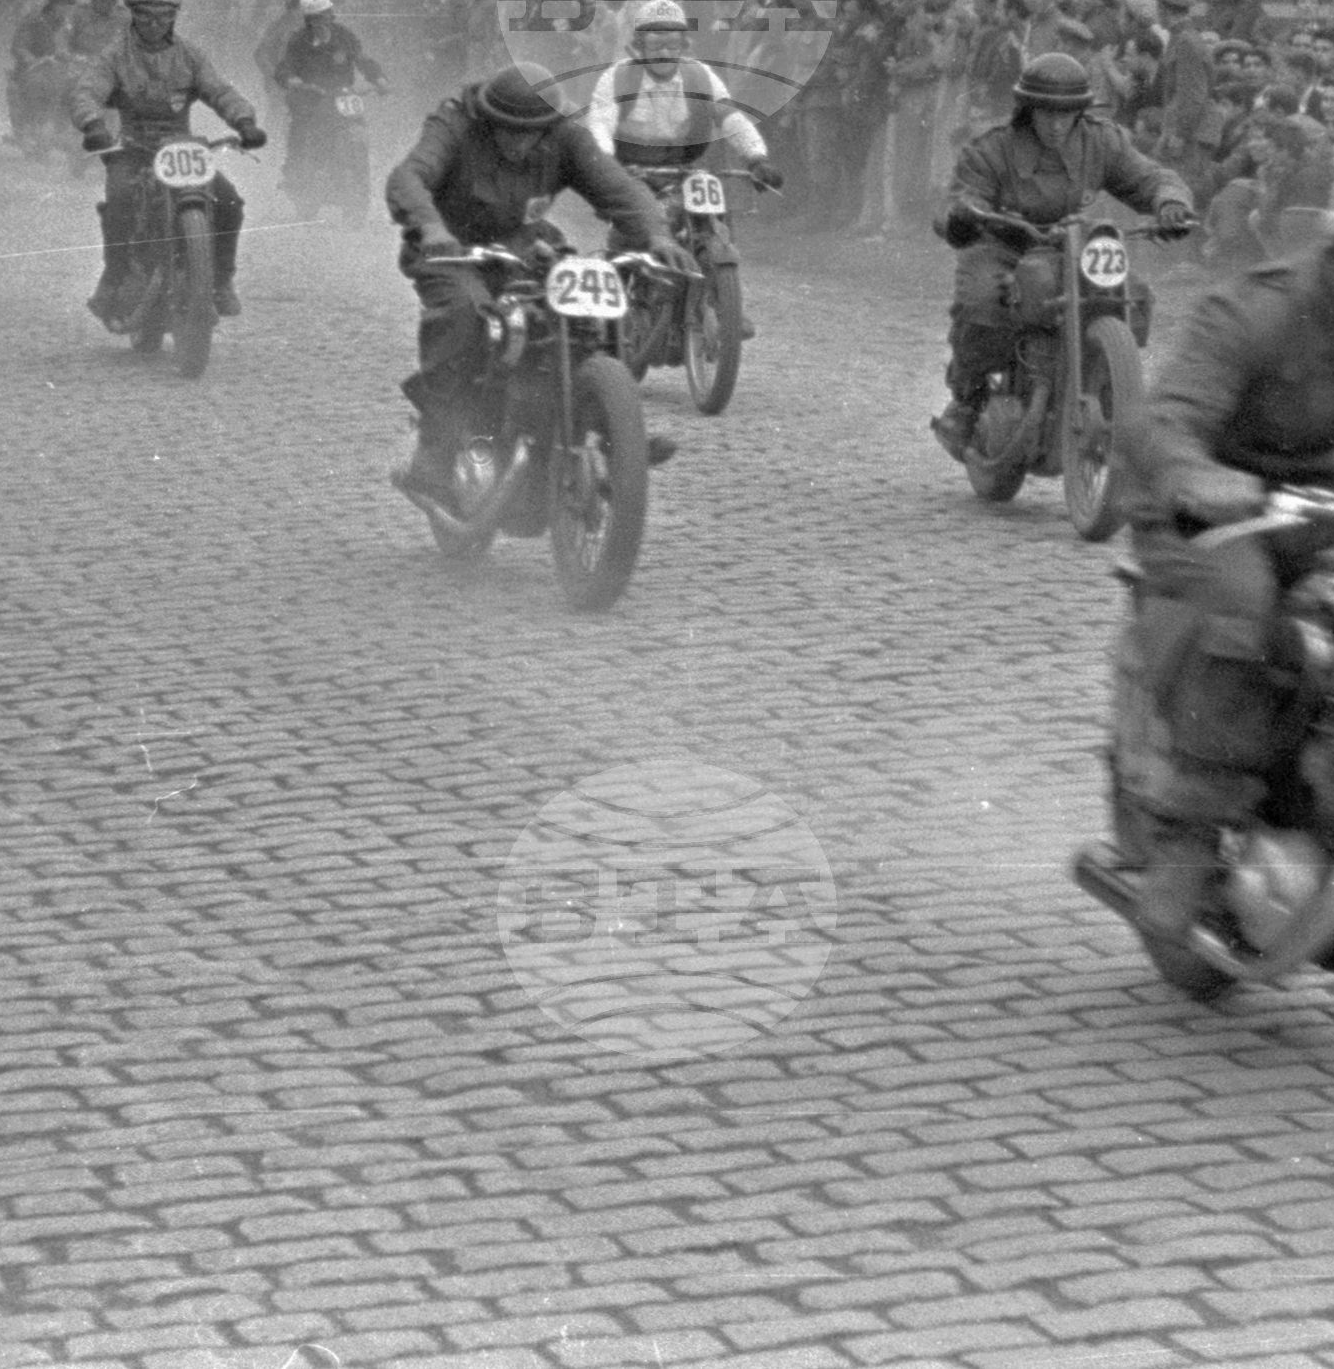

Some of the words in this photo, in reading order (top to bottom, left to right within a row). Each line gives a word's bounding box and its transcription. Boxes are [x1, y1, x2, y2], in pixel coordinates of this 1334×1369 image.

[160, 149, 207, 178] 305
[690, 178, 721, 207] 56
[1087, 247, 1126, 275] 223
[555, 268, 621, 308] 249
